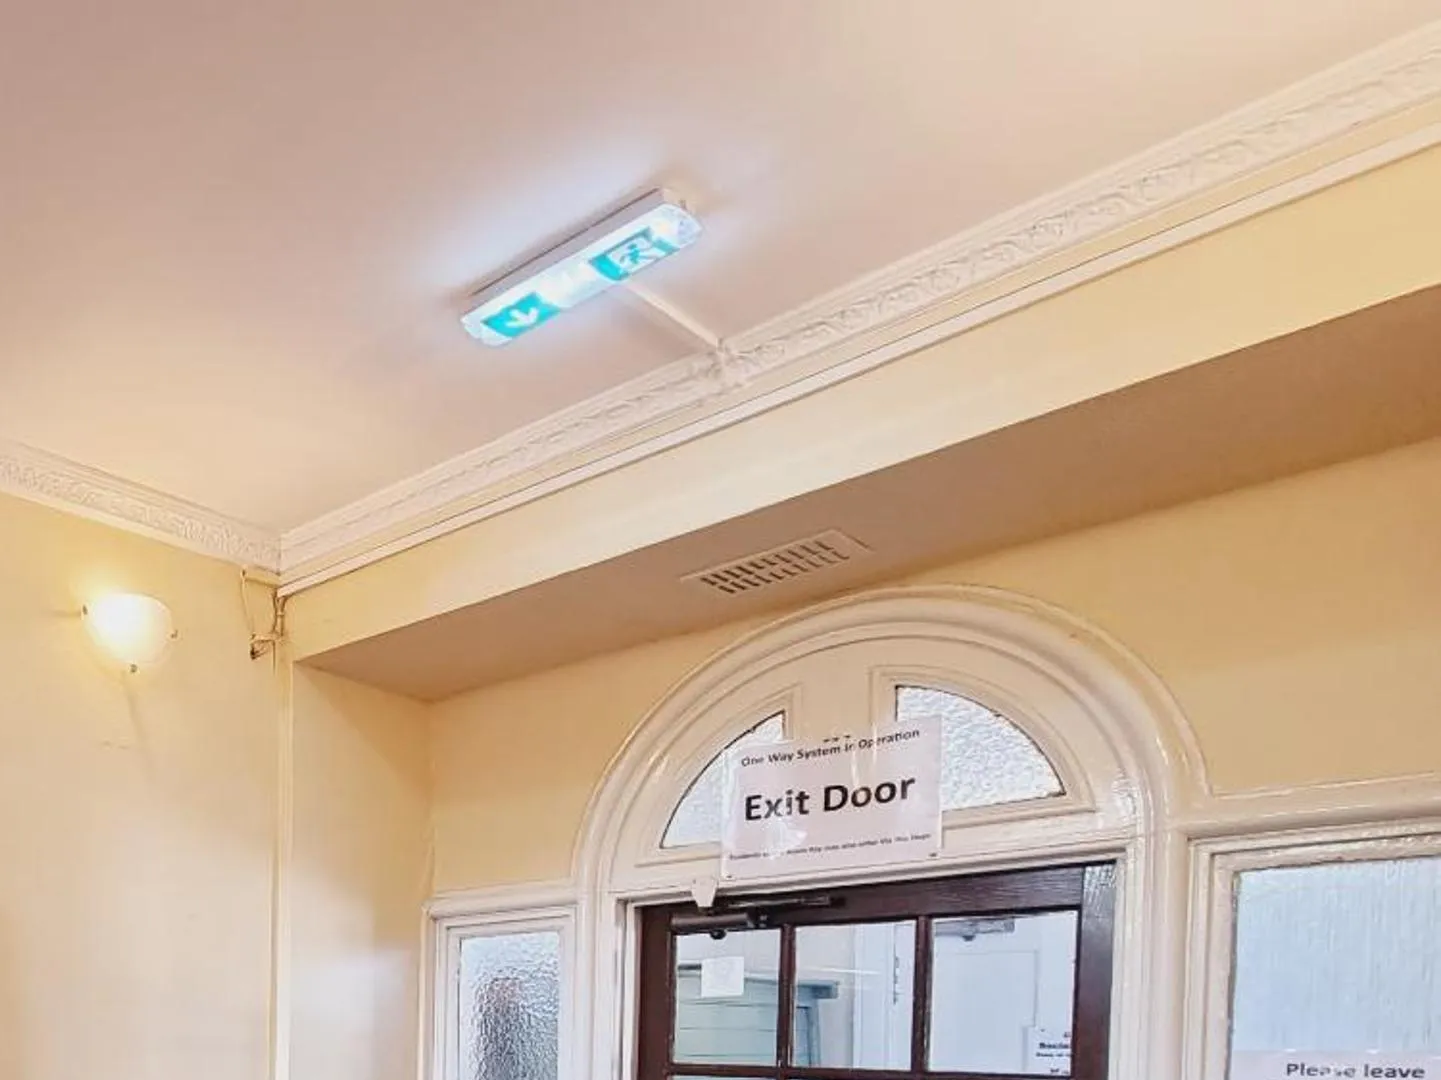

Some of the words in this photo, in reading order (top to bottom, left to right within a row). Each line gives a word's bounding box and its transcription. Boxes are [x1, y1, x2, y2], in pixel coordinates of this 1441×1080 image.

[741, 756, 764, 767] One
[768, 752, 794, 763] Way
[797, 744, 840, 761] System
[745, 789, 809, 821] Exit
[823, 777, 916, 812] Door
[1286, 1063, 1356, 1078] Please
[1364, 1063, 1426, 1079] leave
